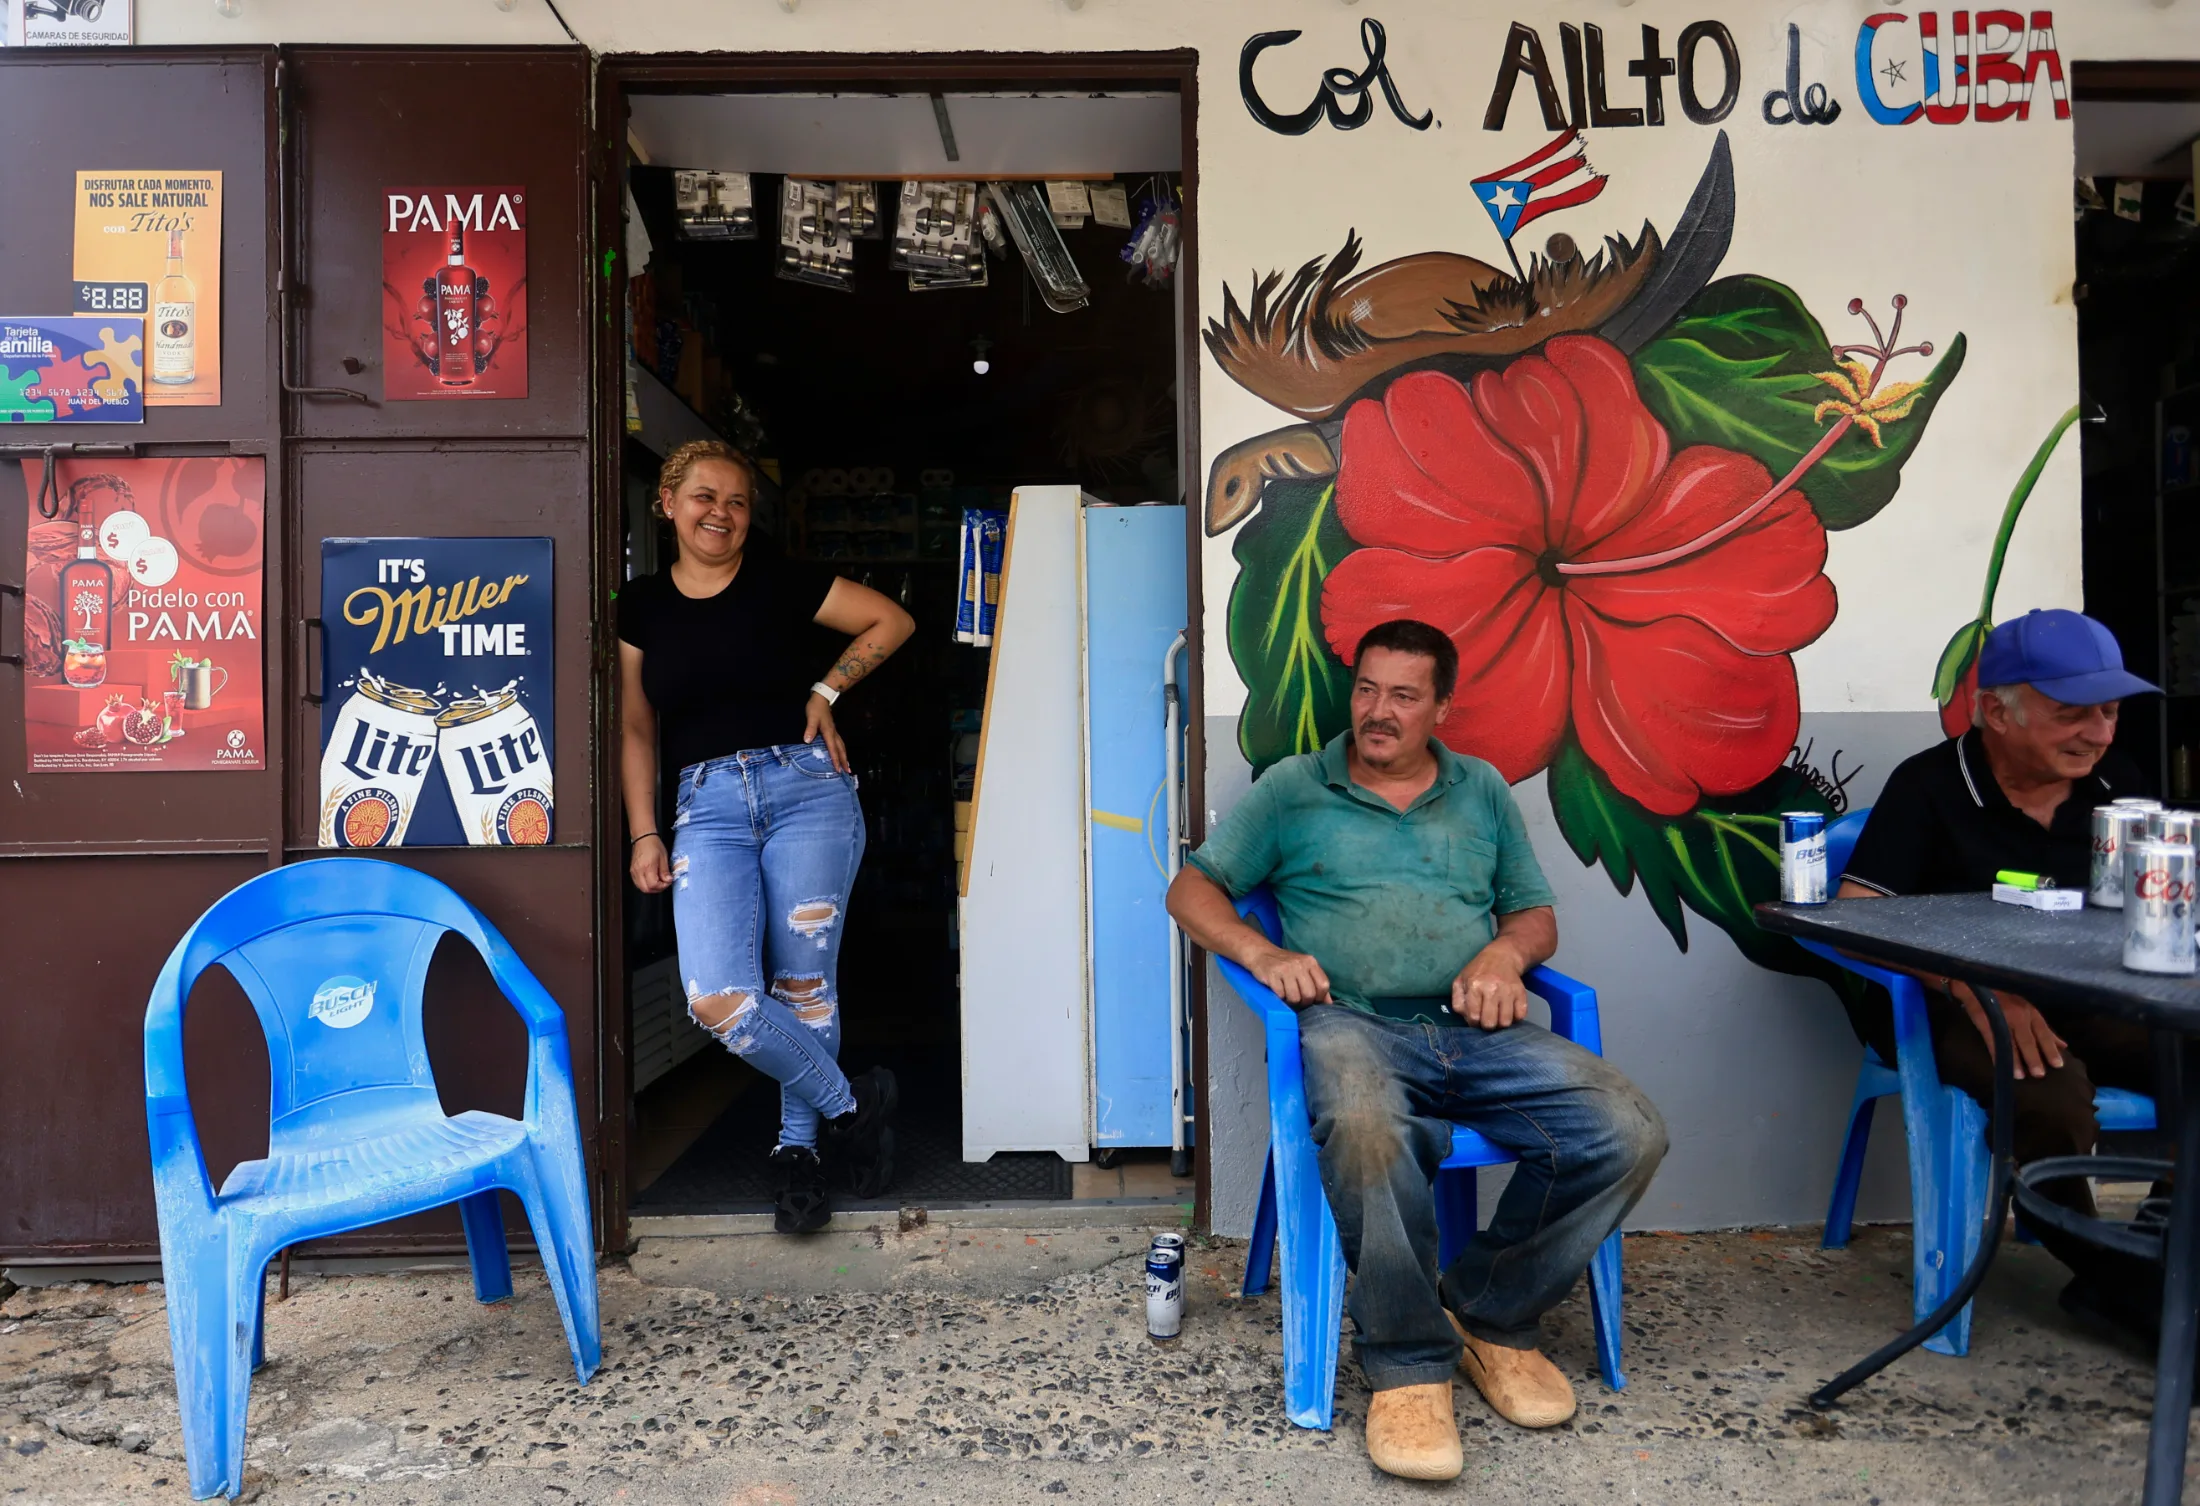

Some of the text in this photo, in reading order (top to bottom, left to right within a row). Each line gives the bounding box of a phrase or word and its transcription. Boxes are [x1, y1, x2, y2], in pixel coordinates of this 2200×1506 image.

[26, 31, 67, 39] CAMARAS
[81, 32, 129, 41] SEGURIDAD
[1761, 22, 1842, 126] de
[1855, 10, 2070, 126] CUBA
[84, 179, 214, 191] DISFRUTAR CADA MOMENTO,
[89, 192, 209, 208] NOS SALE NATURAL
[103, 210, 194, 233] con Tito's
[81, 285, 143, 309] $8.88
[440, 284, 471, 296] PAMA
[157, 305, 192, 318] Tito's
[4, 326, 39, 339] Tarjeta
[20, 388, 42, 397] 1234
[77, 388, 100, 396] 1234
[67, 398, 87, 406] JUAN
[103, 398, 130, 406] PUEBLO
[378, 559, 426, 583] IT'S
[72, 579, 104, 587] PAMA
[128, 588, 245, 608] Pídelo con
[343, 574, 529, 655] Miller
[216, 748, 255, 759] PAMA
[340, 718, 433, 781] Lite
[455, 726, 540, 795] Lite
[341, 788, 398, 823] A FINE PILSNER
[497, 790, 551, 831] A FINE PILSNER
[308, 980, 378, 1019] BUSCH
[329, 999, 365, 1018] LIGHT
